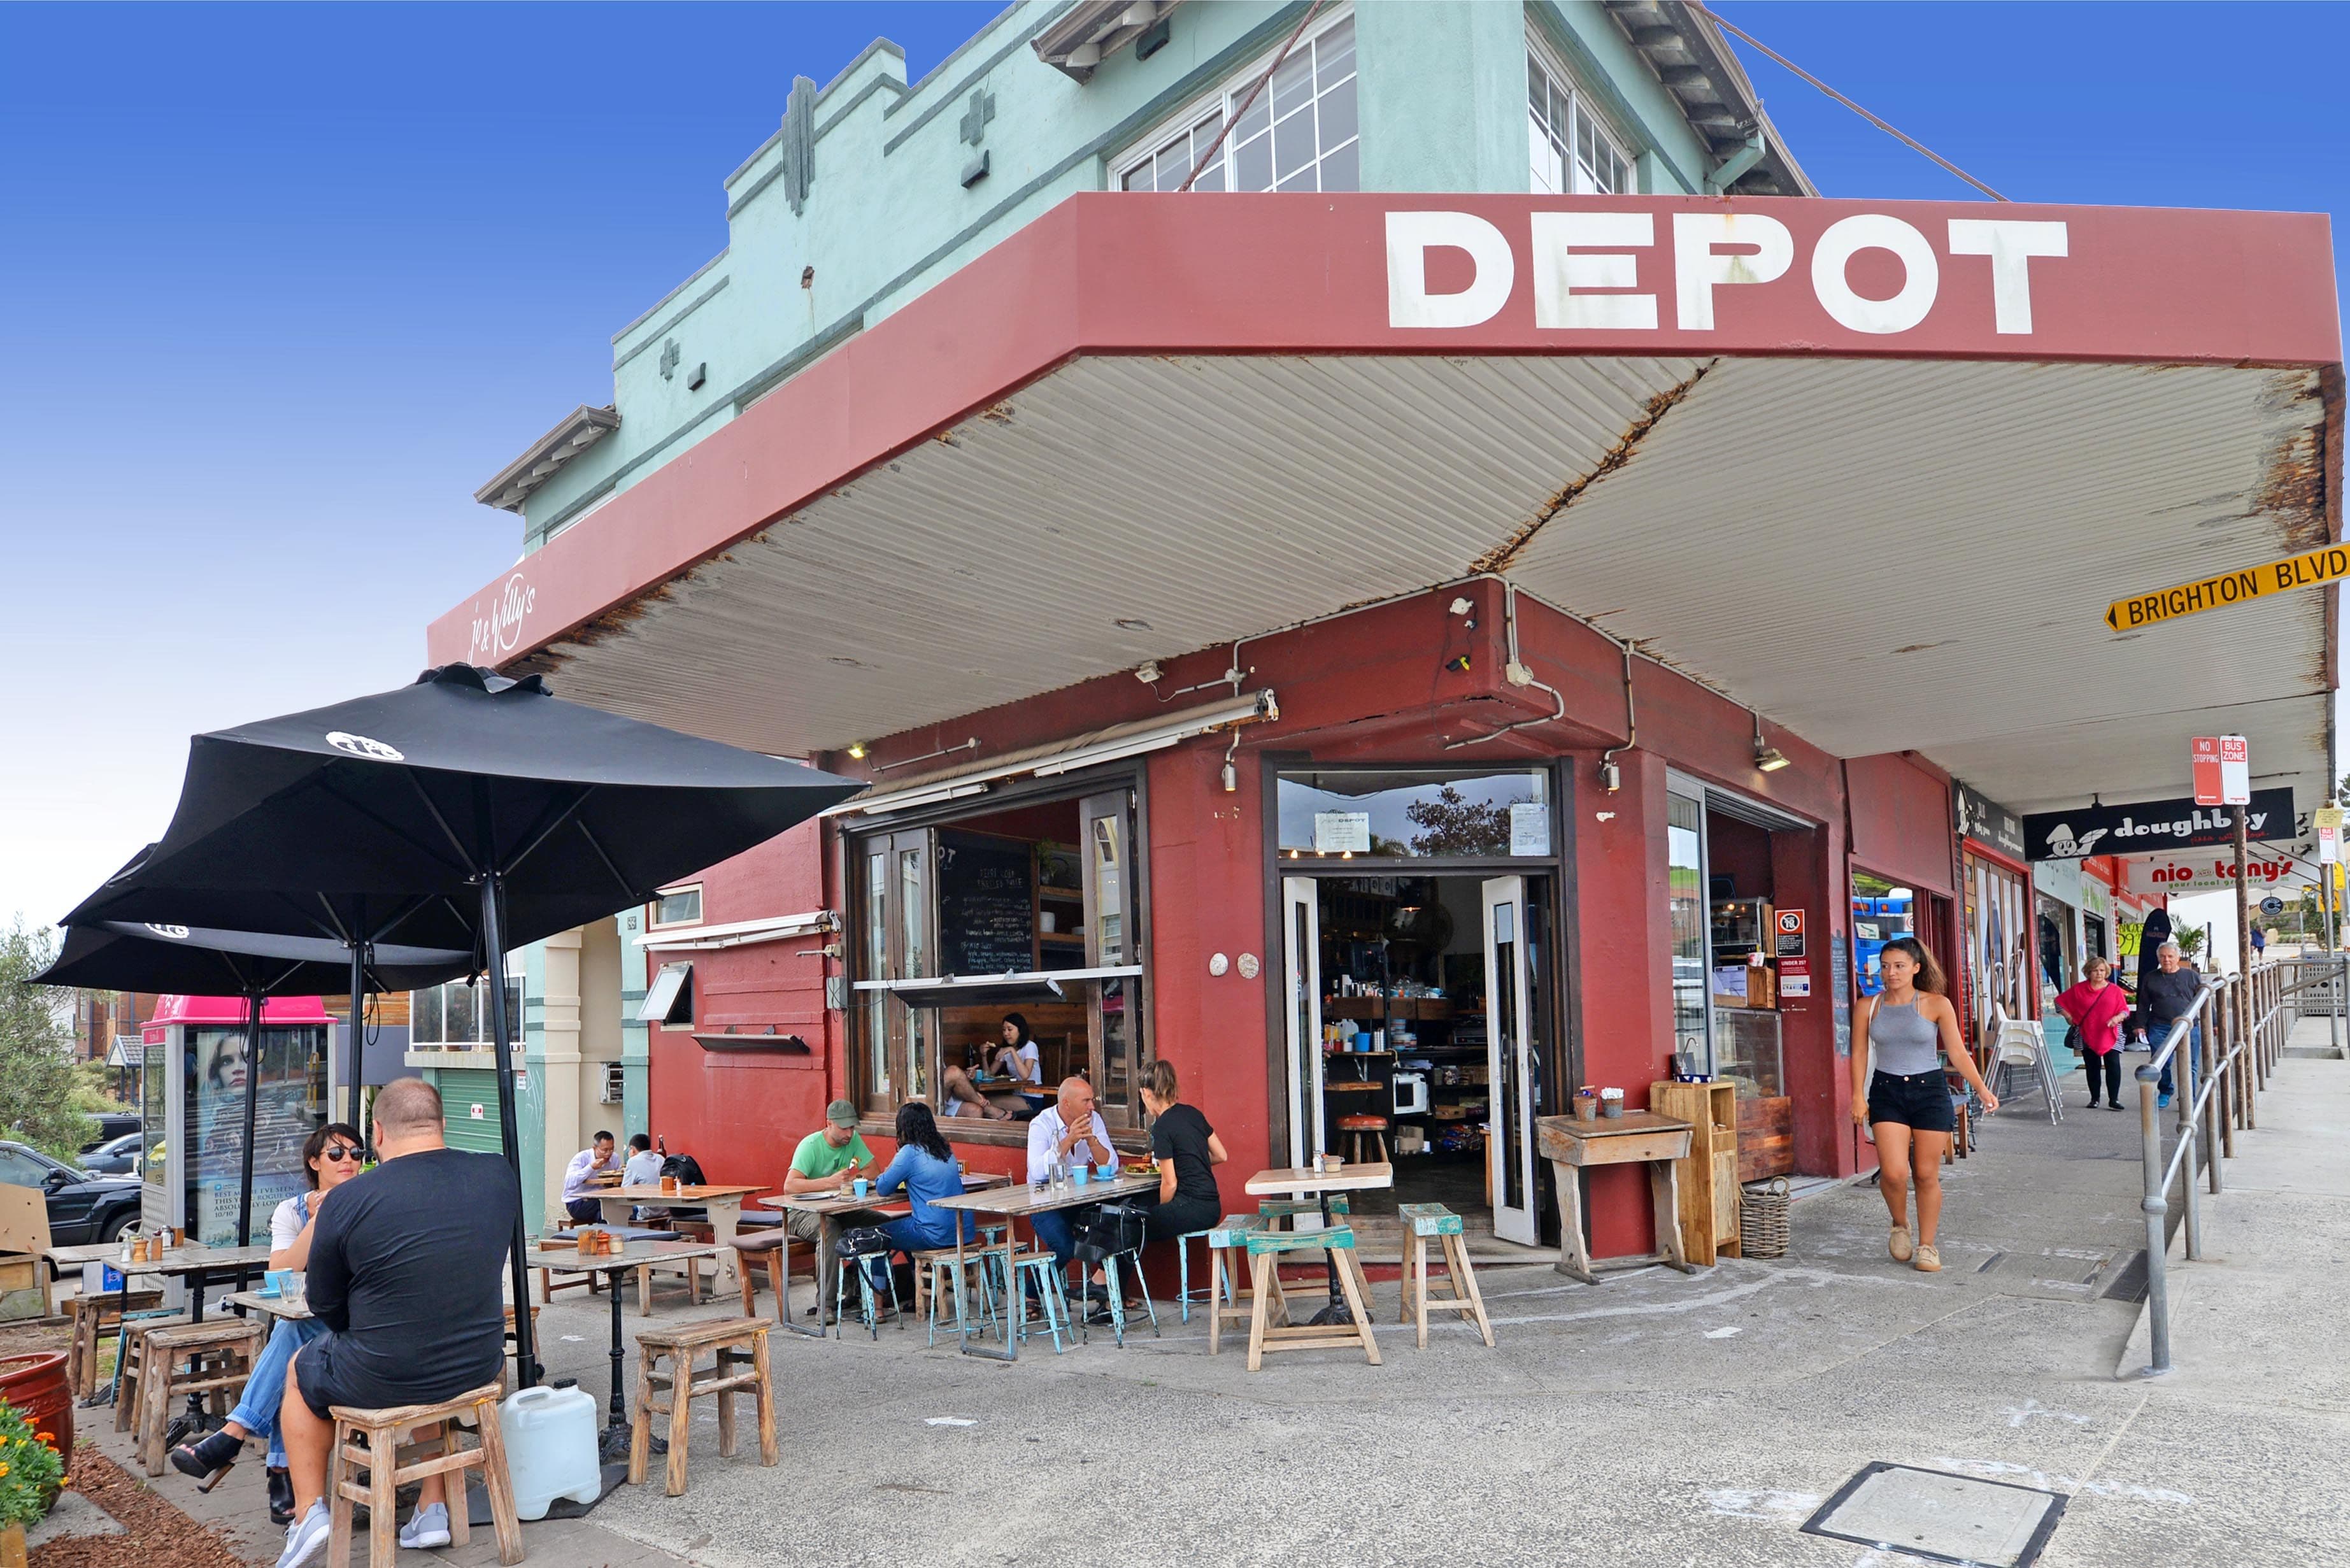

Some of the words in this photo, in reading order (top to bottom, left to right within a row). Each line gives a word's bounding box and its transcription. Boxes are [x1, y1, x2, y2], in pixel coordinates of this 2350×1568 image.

[1385, 211, 2069, 334] DEPOT
[2127, 571, 2259, 625] BRIGHTON
[2275, 550, 2347, 589] BLVD
[2199, 741, 2211, 752] NO
[2225, 741, 2242, 751] BUS
[2193, 754, 2219, 764] STOPPING
[2223, 752, 2245, 760] ZONE
[2152, 863, 2193, 883] nio
[2215, 855, 2293, 881] tony's
[2223, 878, 2262, 887] grers
[1784, 919, 1795, 929] 18
